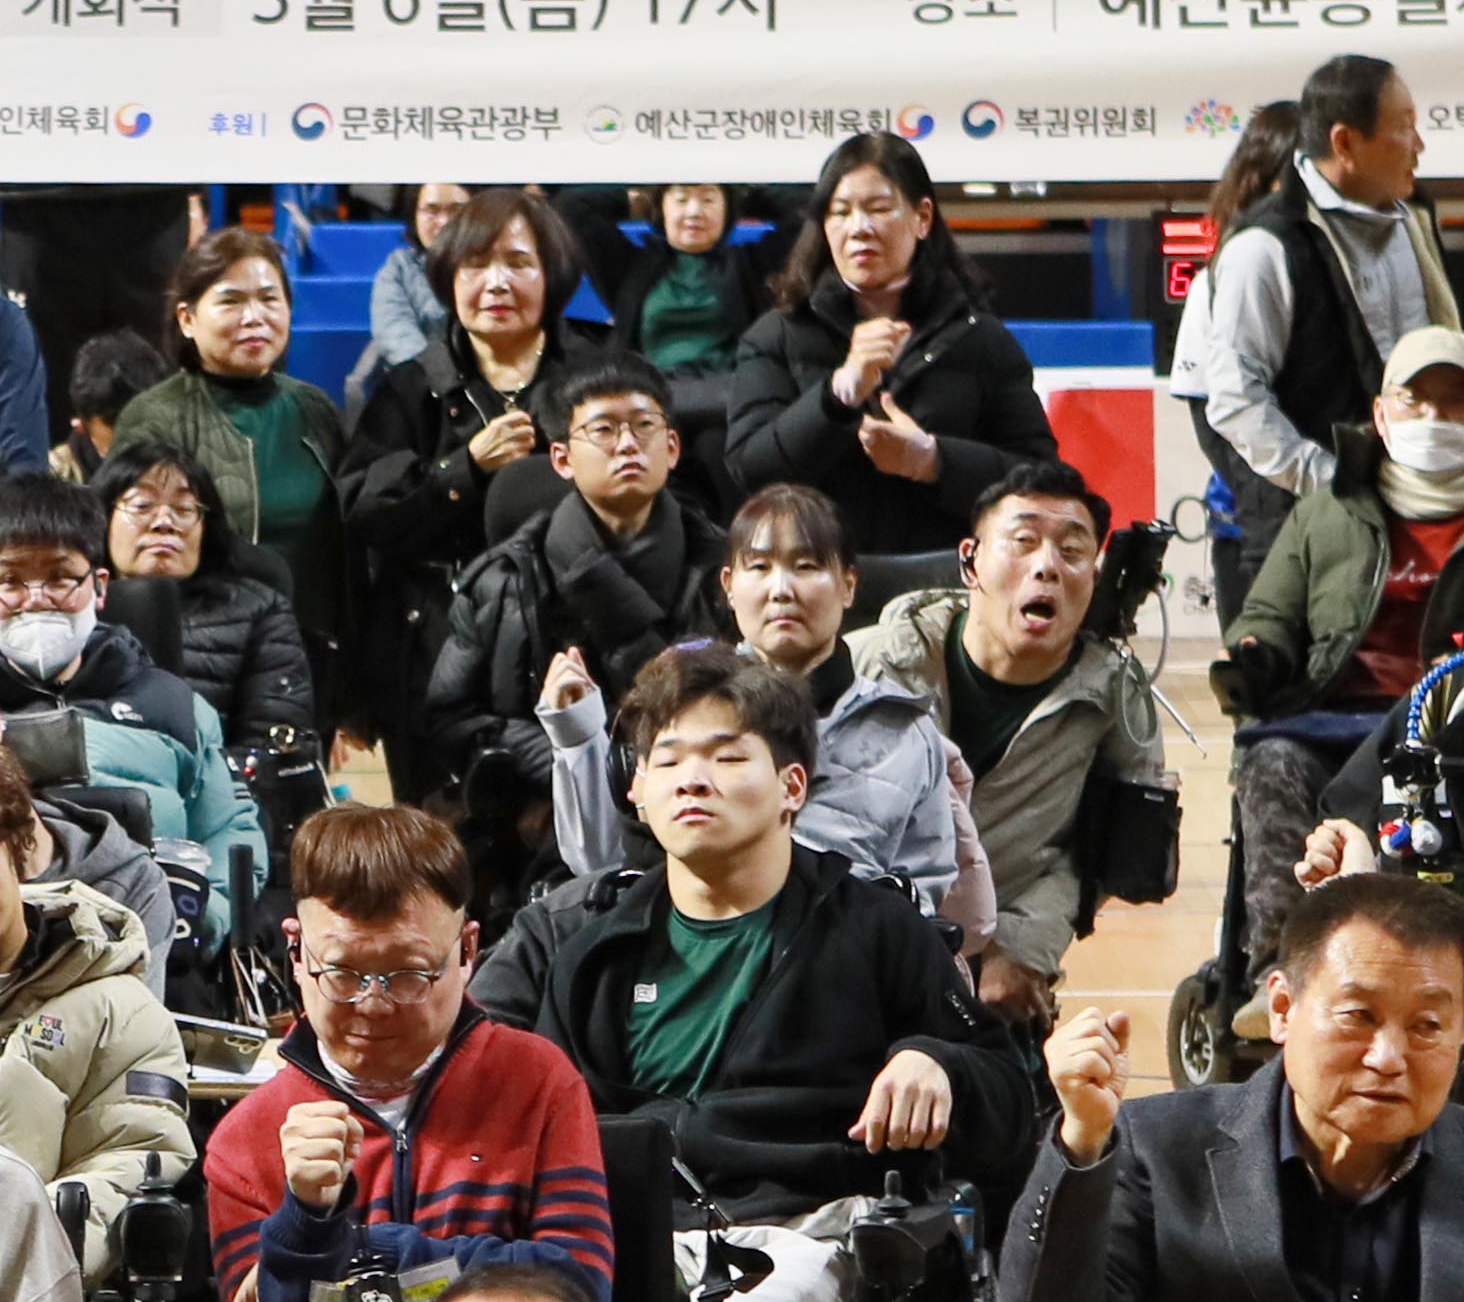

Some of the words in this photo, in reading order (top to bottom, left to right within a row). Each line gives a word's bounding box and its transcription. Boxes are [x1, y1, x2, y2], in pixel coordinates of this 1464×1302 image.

[208, 113, 255, 137] 후원
[339, 105, 563, 141] 문화체육관광부
[1014, 106, 1157, 138] 복권위원회
